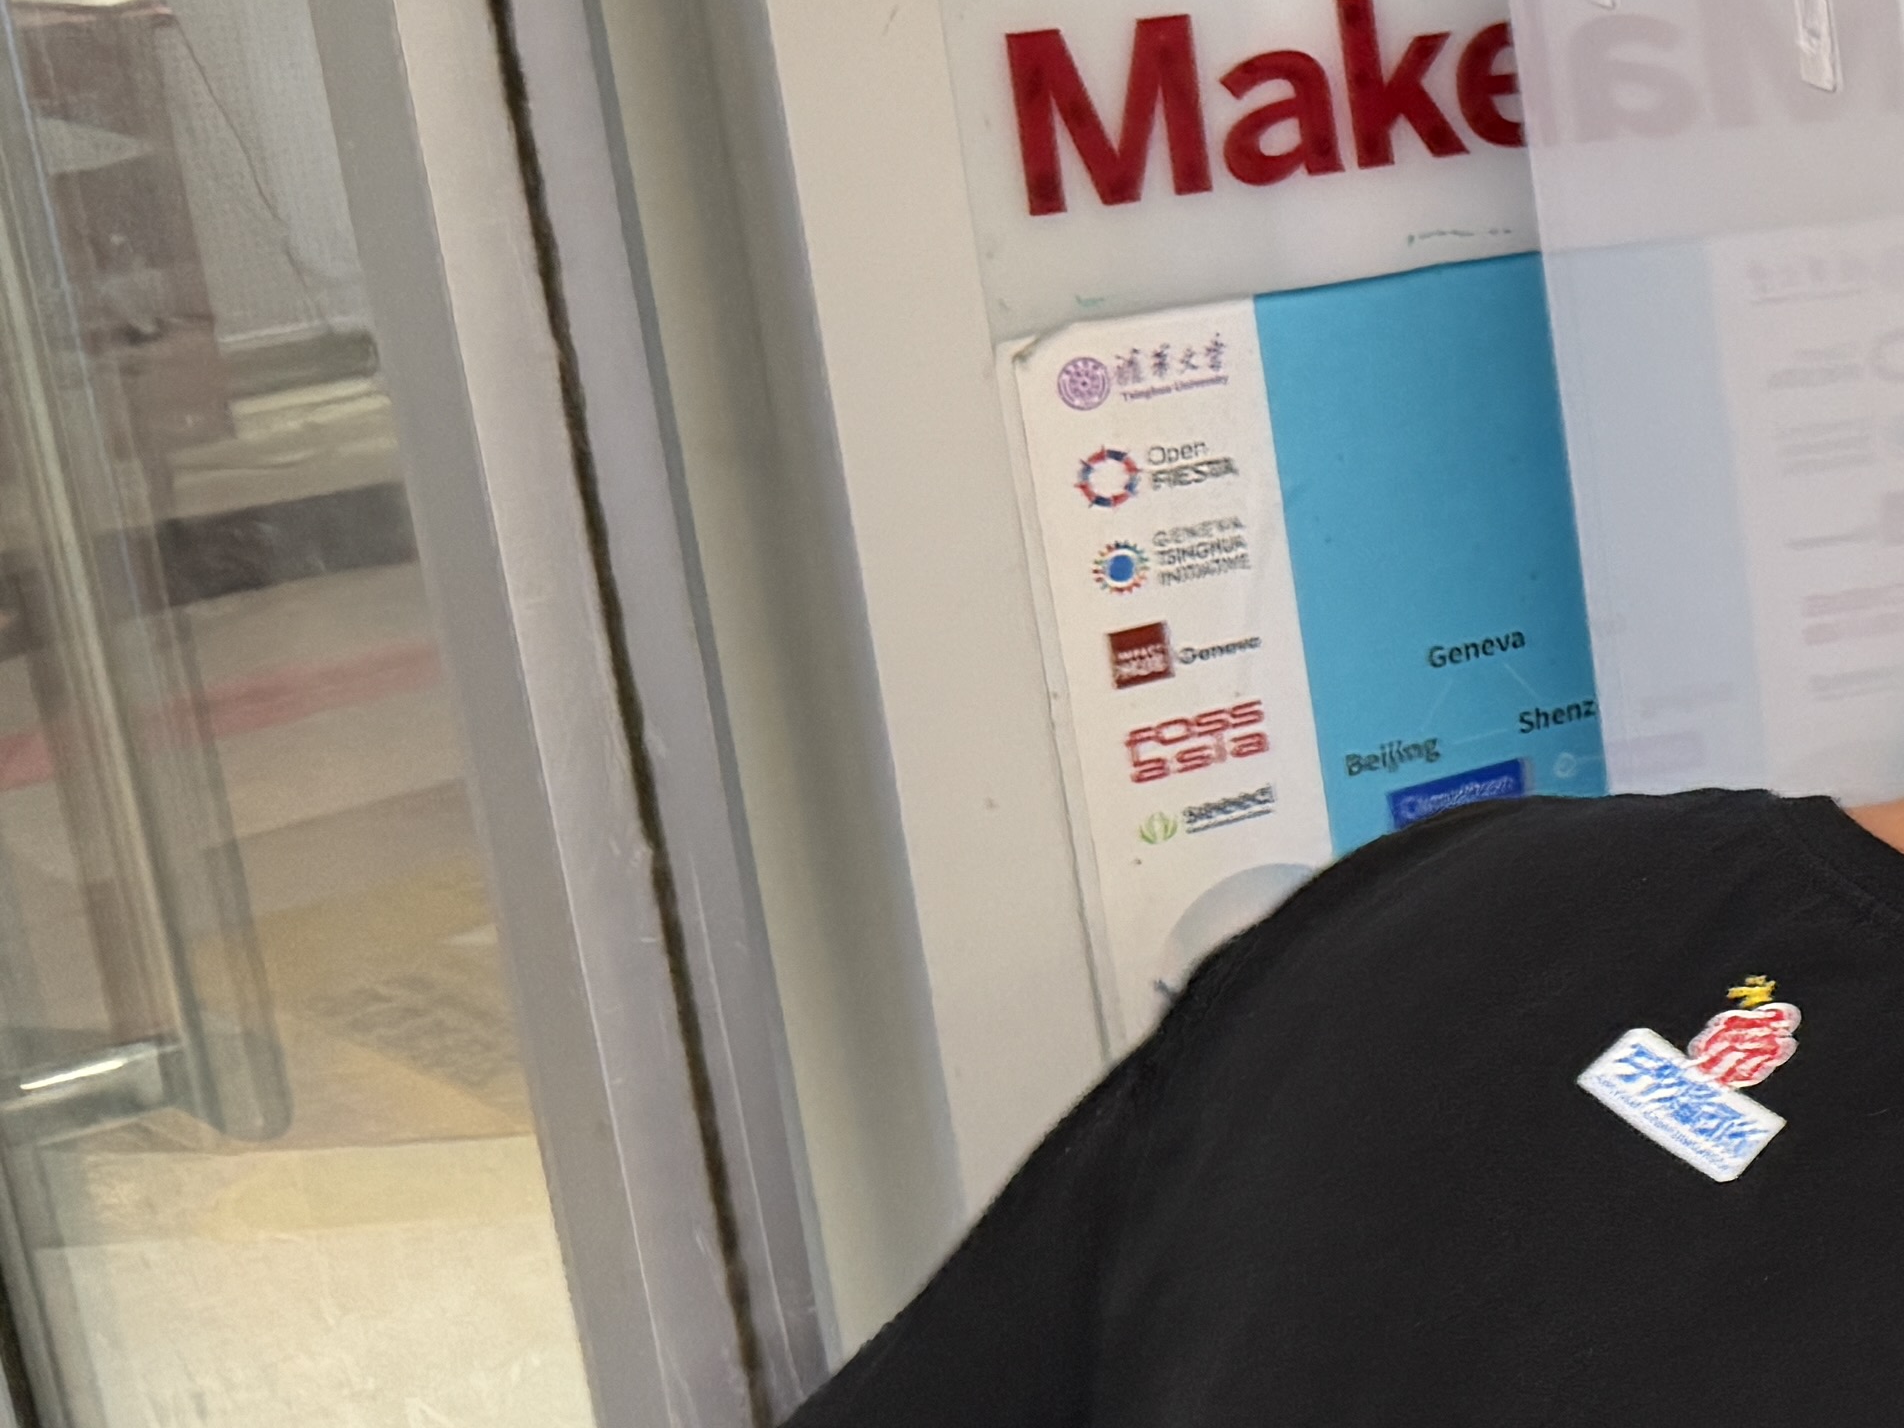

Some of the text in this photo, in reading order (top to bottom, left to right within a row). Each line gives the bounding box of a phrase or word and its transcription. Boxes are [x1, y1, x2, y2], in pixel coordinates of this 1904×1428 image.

[1147, 440, 1208, 466] Open
[1428, 630, 1527, 669] Geneva
[1344, 737, 1442, 776] Beijing
